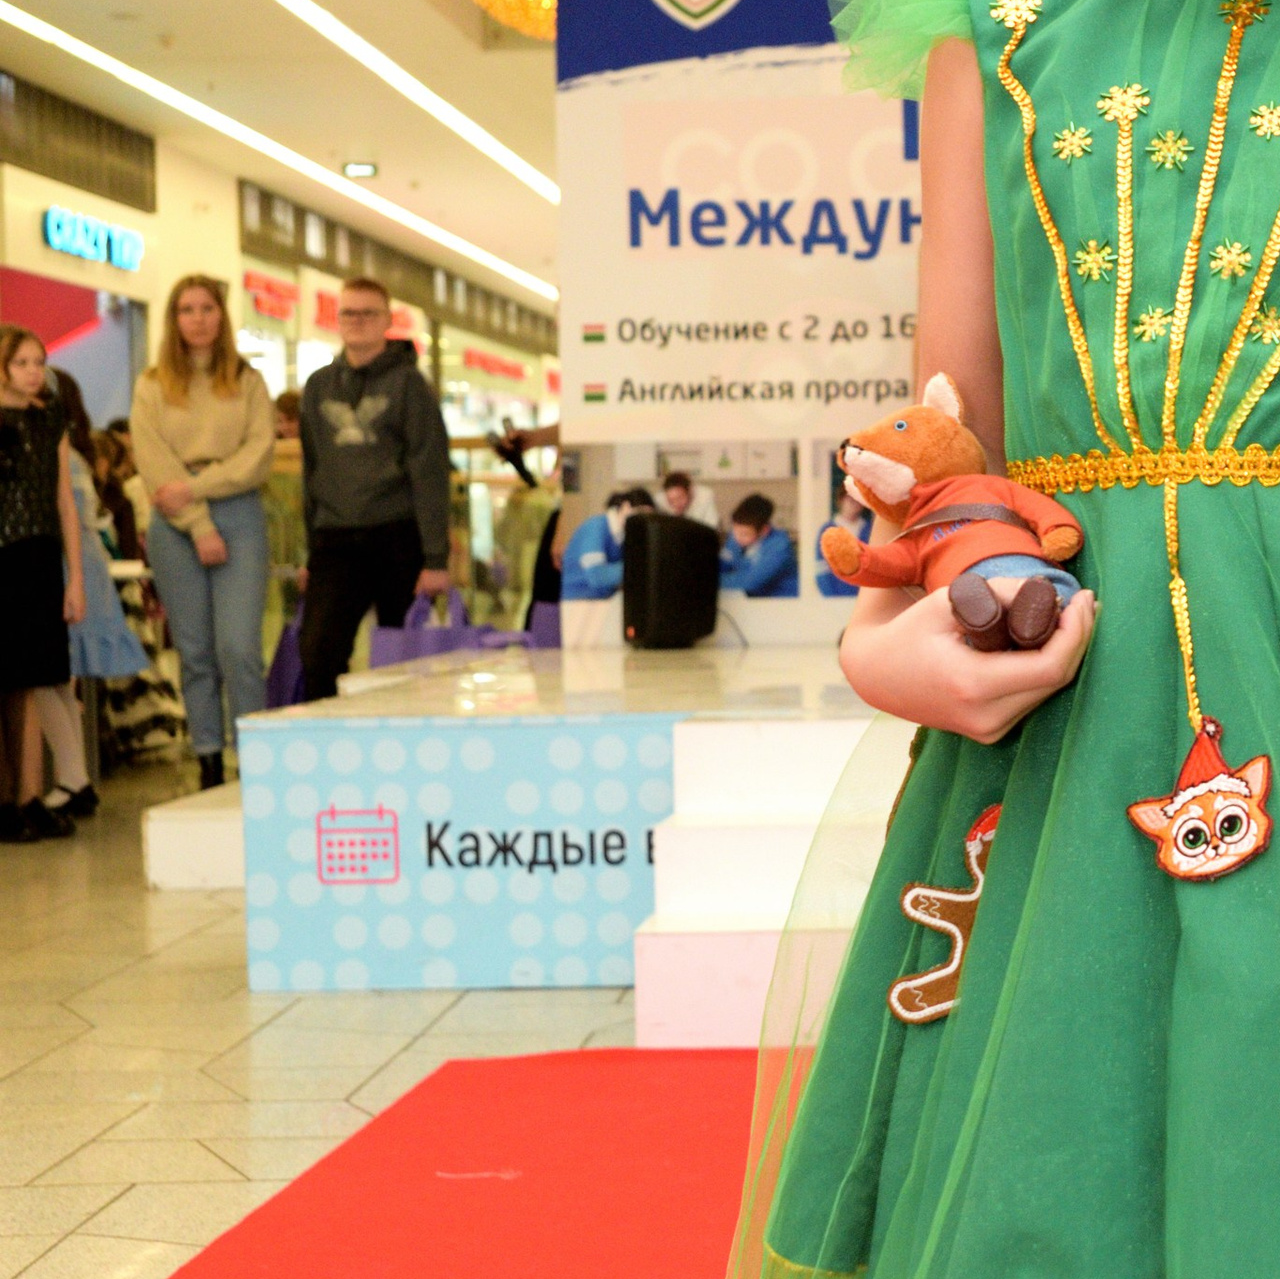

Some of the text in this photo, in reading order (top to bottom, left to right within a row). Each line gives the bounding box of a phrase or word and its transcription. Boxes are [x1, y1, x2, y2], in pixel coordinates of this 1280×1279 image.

[617, 318, 768, 348] Обучение
[803, 314, 820, 341] 2
[830, 321, 869, 345] до
[881, 313, 917, 340] 16
[618, 376, 910, 406] Английская програ
[425, 820, 627, 874] Каждые
